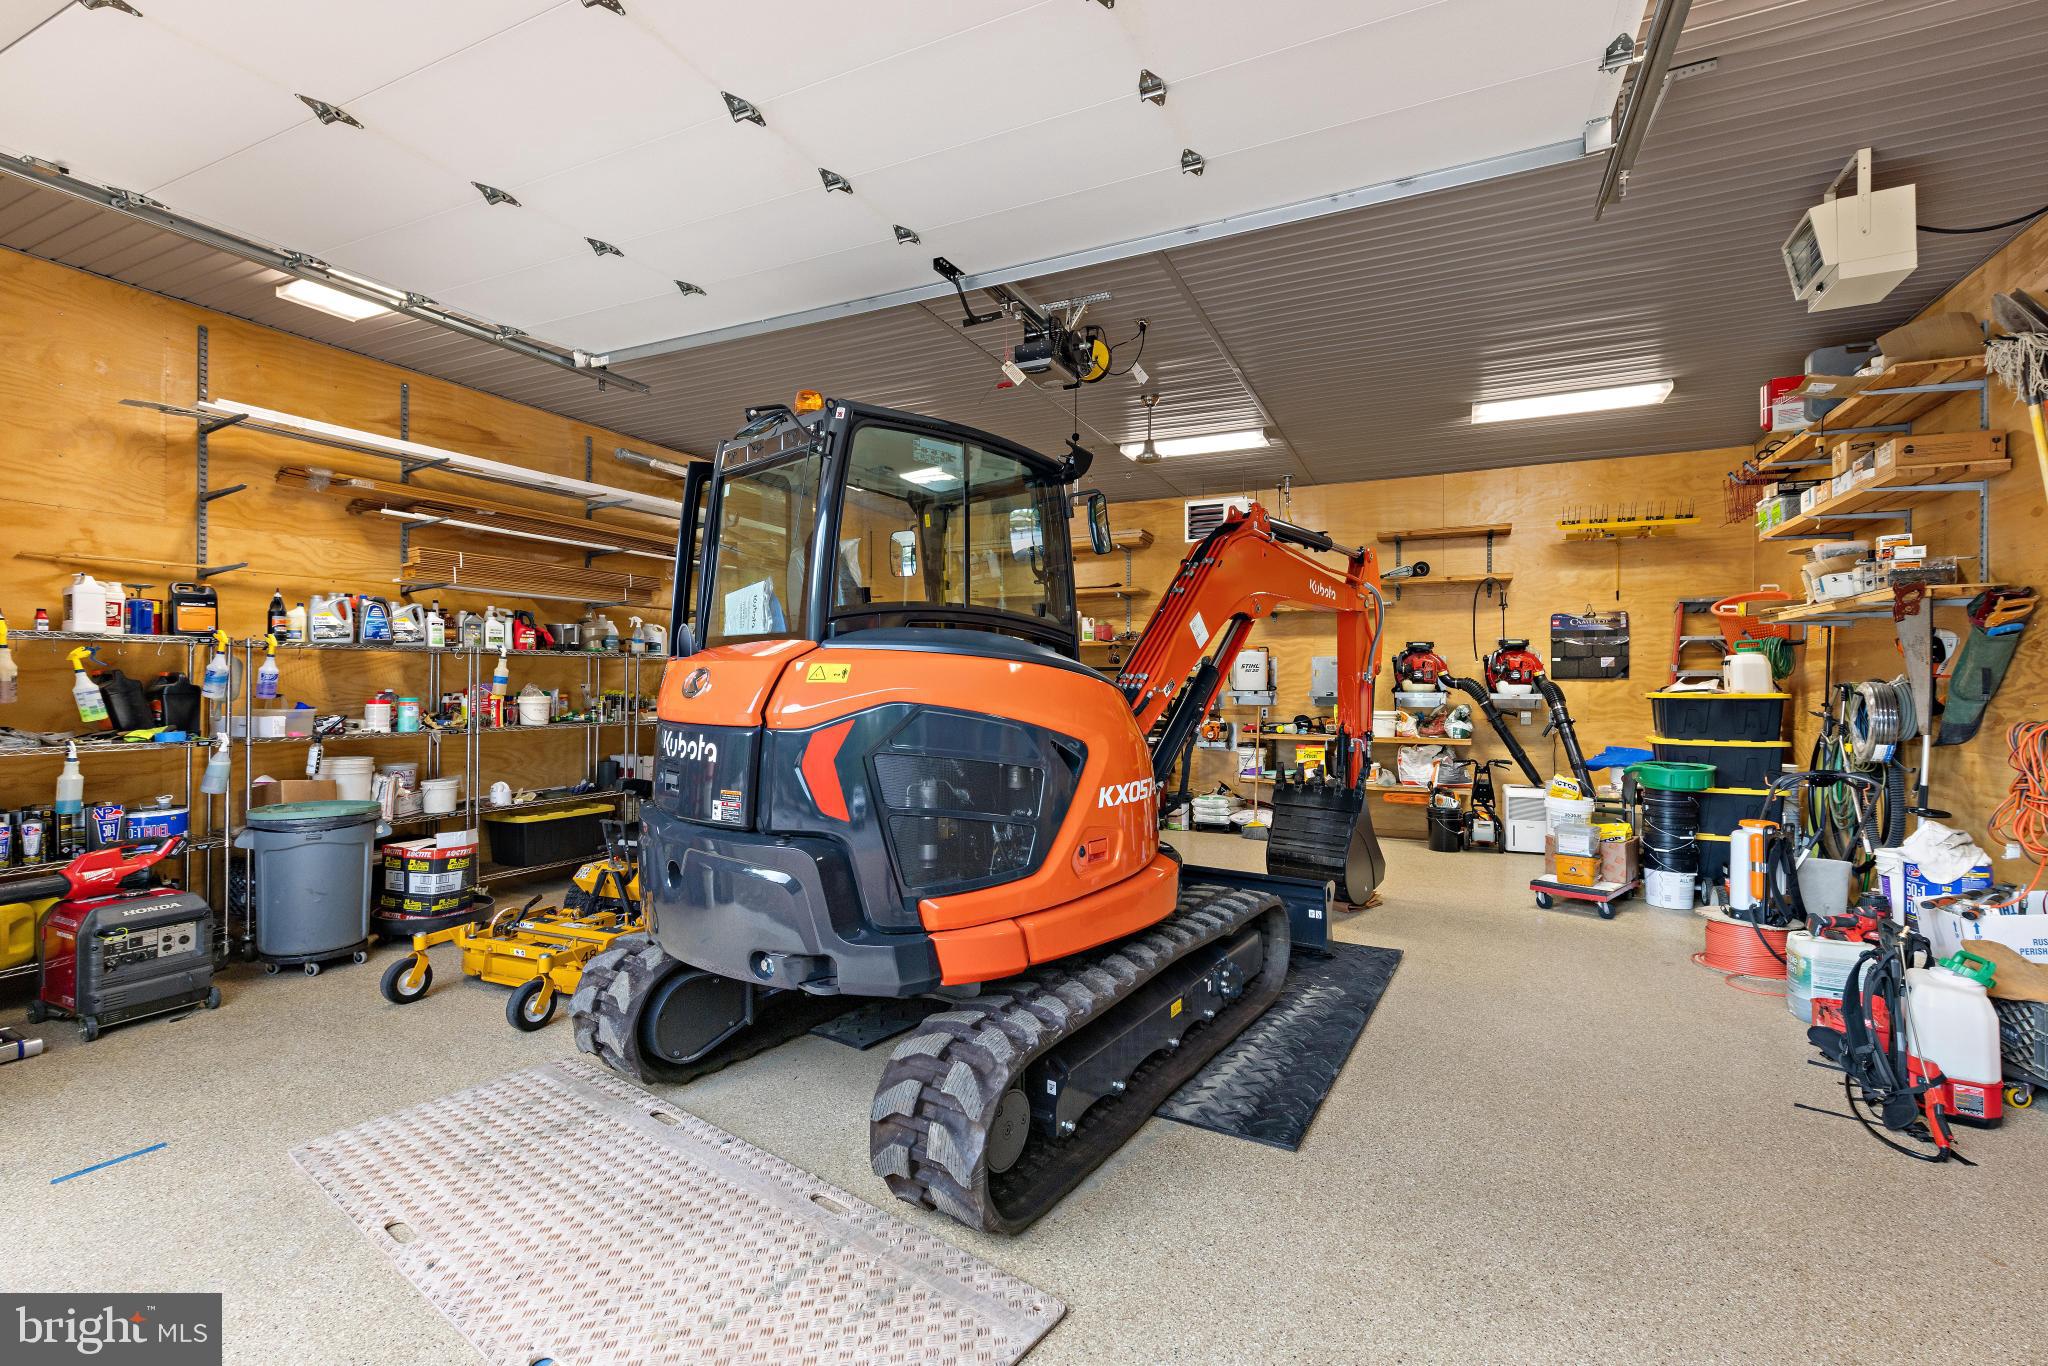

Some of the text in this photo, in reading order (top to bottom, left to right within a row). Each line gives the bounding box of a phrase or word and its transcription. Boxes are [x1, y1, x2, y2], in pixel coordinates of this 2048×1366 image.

[1309, 578, 1336, 600] Kubota
[663, 729, 718, 763] Kubota
[143, 823, 170, 838] FUEL
[446, 847, 473, 857] LOCTITE
[1906, 881, 1926, 897] 50:1
[122, 902, 183, 917] HONDA
